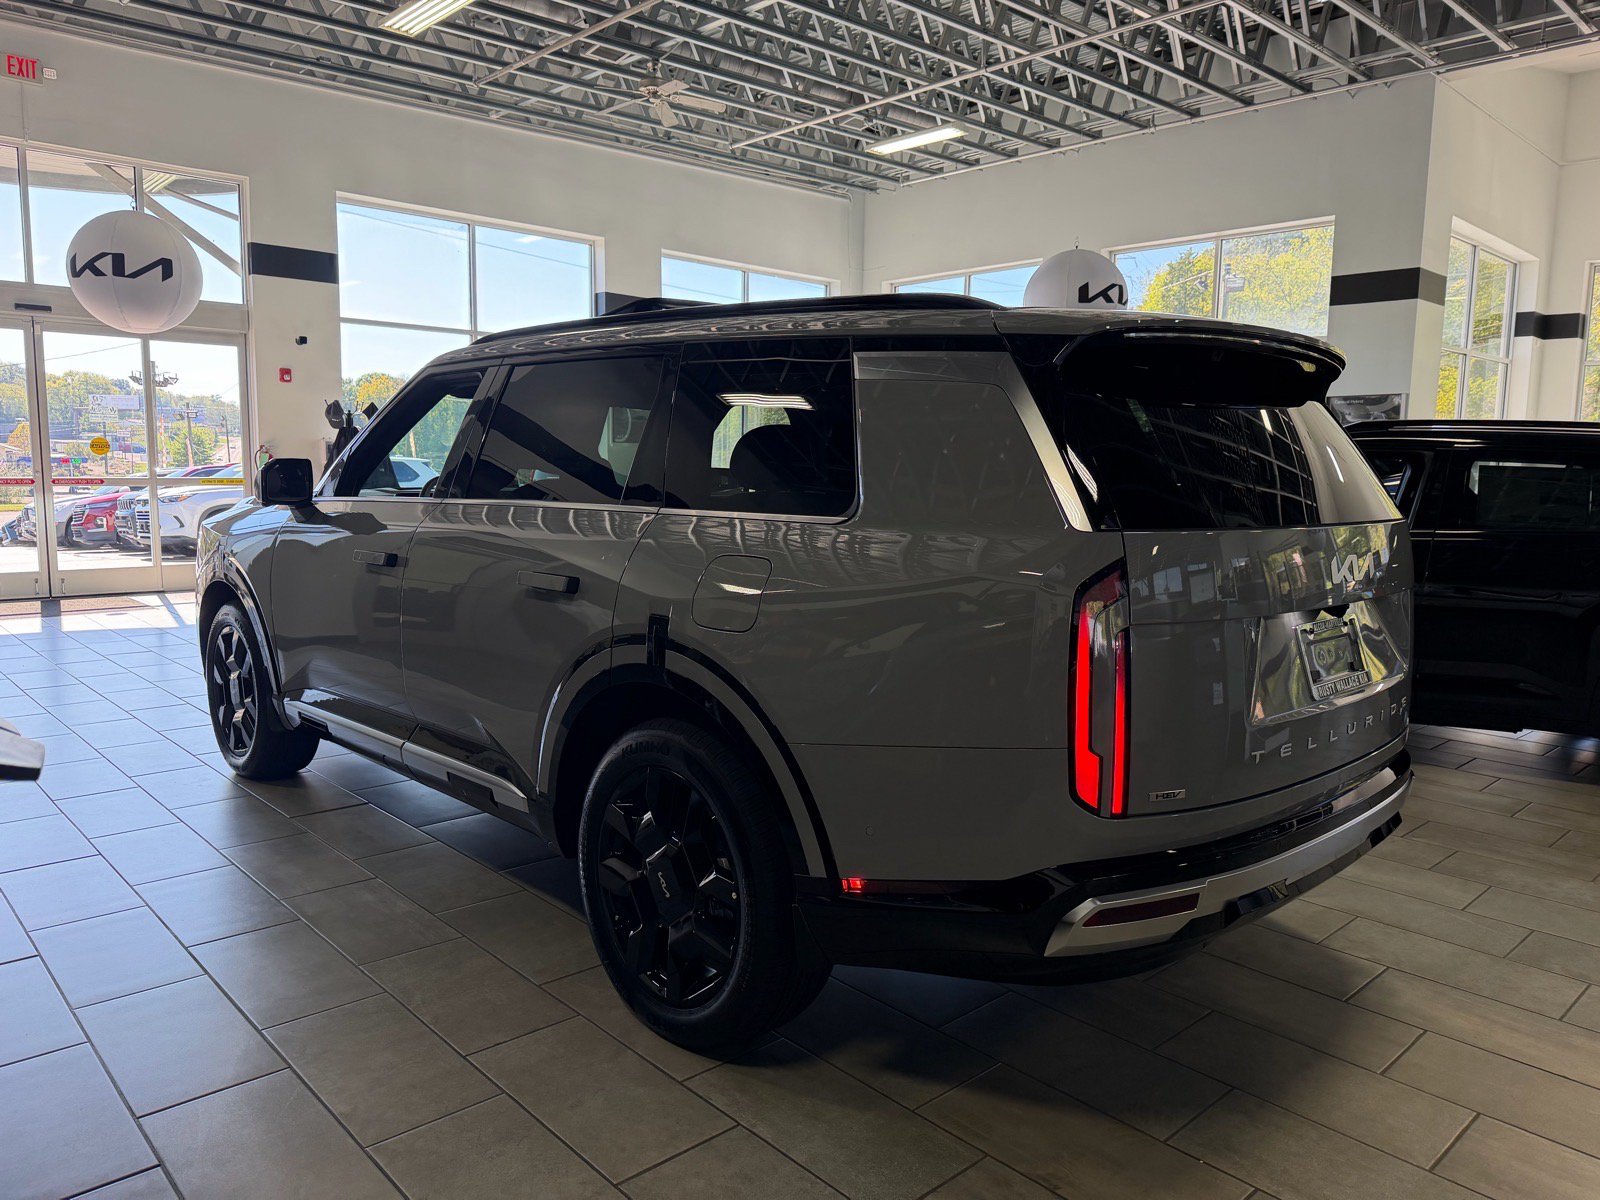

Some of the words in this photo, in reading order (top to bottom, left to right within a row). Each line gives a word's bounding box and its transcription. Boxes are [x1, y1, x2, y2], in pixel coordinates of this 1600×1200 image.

[7, 55, 37, 79] EXIT
[70, 252, 173, 282] KIA
[1331, 552, 1375, 584] KIA
[1317, 683, 1336, 698] RUSTY
[1336, 676, 1360, 692] WALLACE
[1359, 673, 1369, 686] KIA
[621, 741, 670, 756] KUMHO
[1155, 790, 1182, 800] HEV
